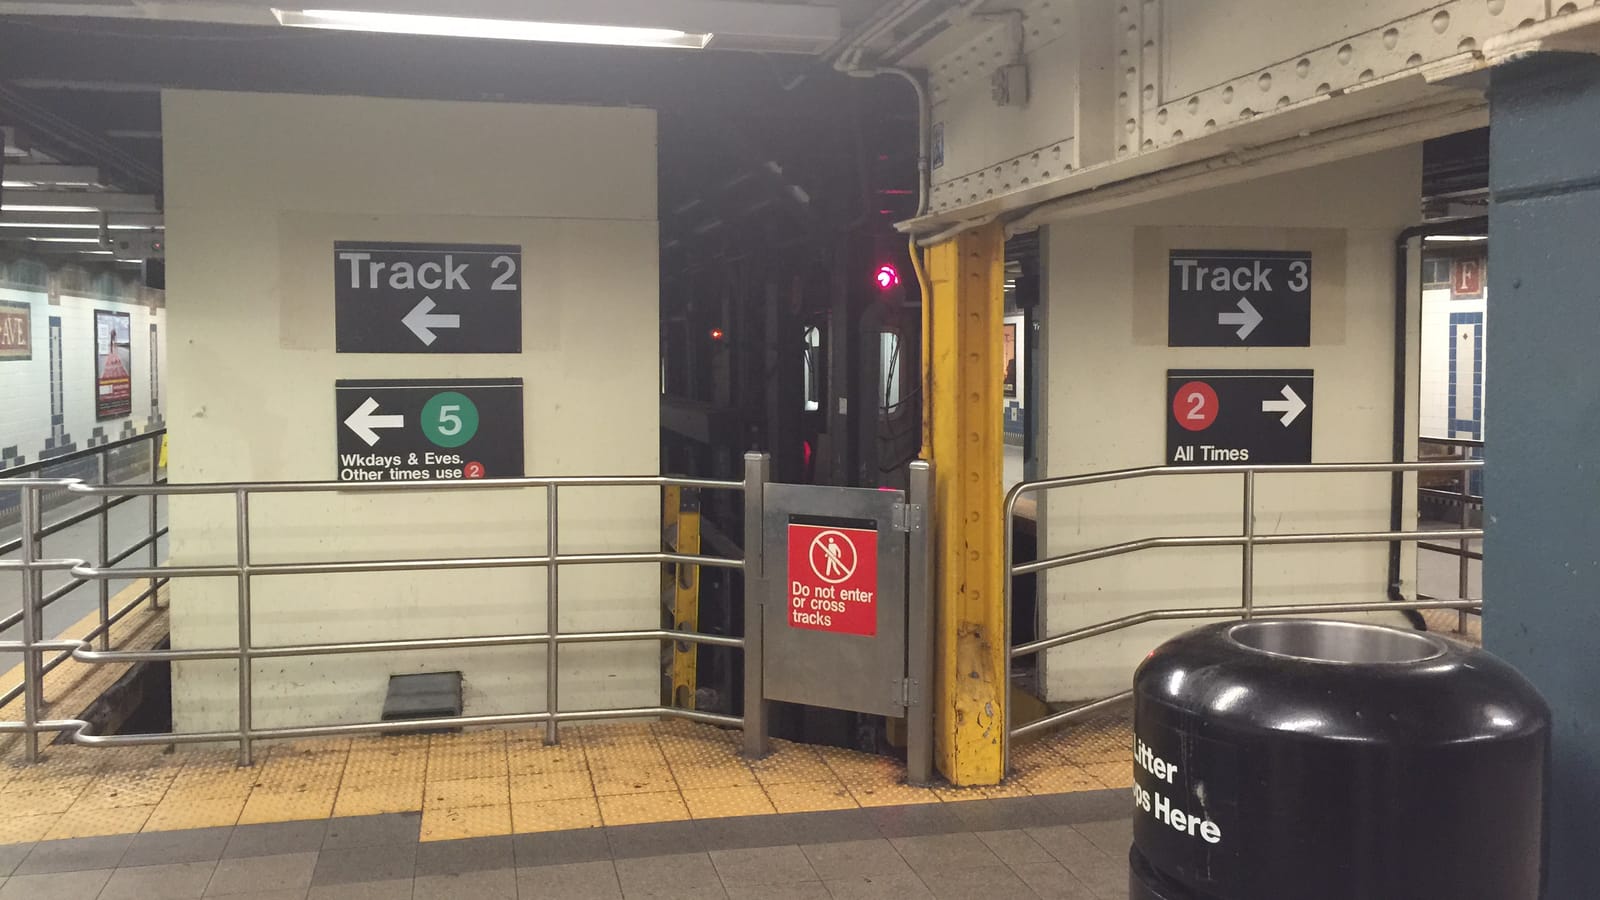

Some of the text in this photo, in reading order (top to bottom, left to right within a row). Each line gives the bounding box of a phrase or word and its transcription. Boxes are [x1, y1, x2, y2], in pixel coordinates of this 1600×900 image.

[339, 252, 517, 291] Track 2
[1173, 259, 1309, 293] Track 3
[1461, 261, 1475, 290] F
[1186, 392, 1205, 420] 2
[437, 405, 463, 436] 5
[340, 452, 464, 469] Wkdays & Eves.
[1173, 445, 1249, 462] All Times
[340, 465, 480, 481] Other times use 2
[792, 581, 874, 603] Do not enter
[792, 597, 845, 612] or cross
[792, 609, 831, 626] tracks
[1133, 732, 1178, 784] Litter
[1132, 777, 1222, 844] ps Here
